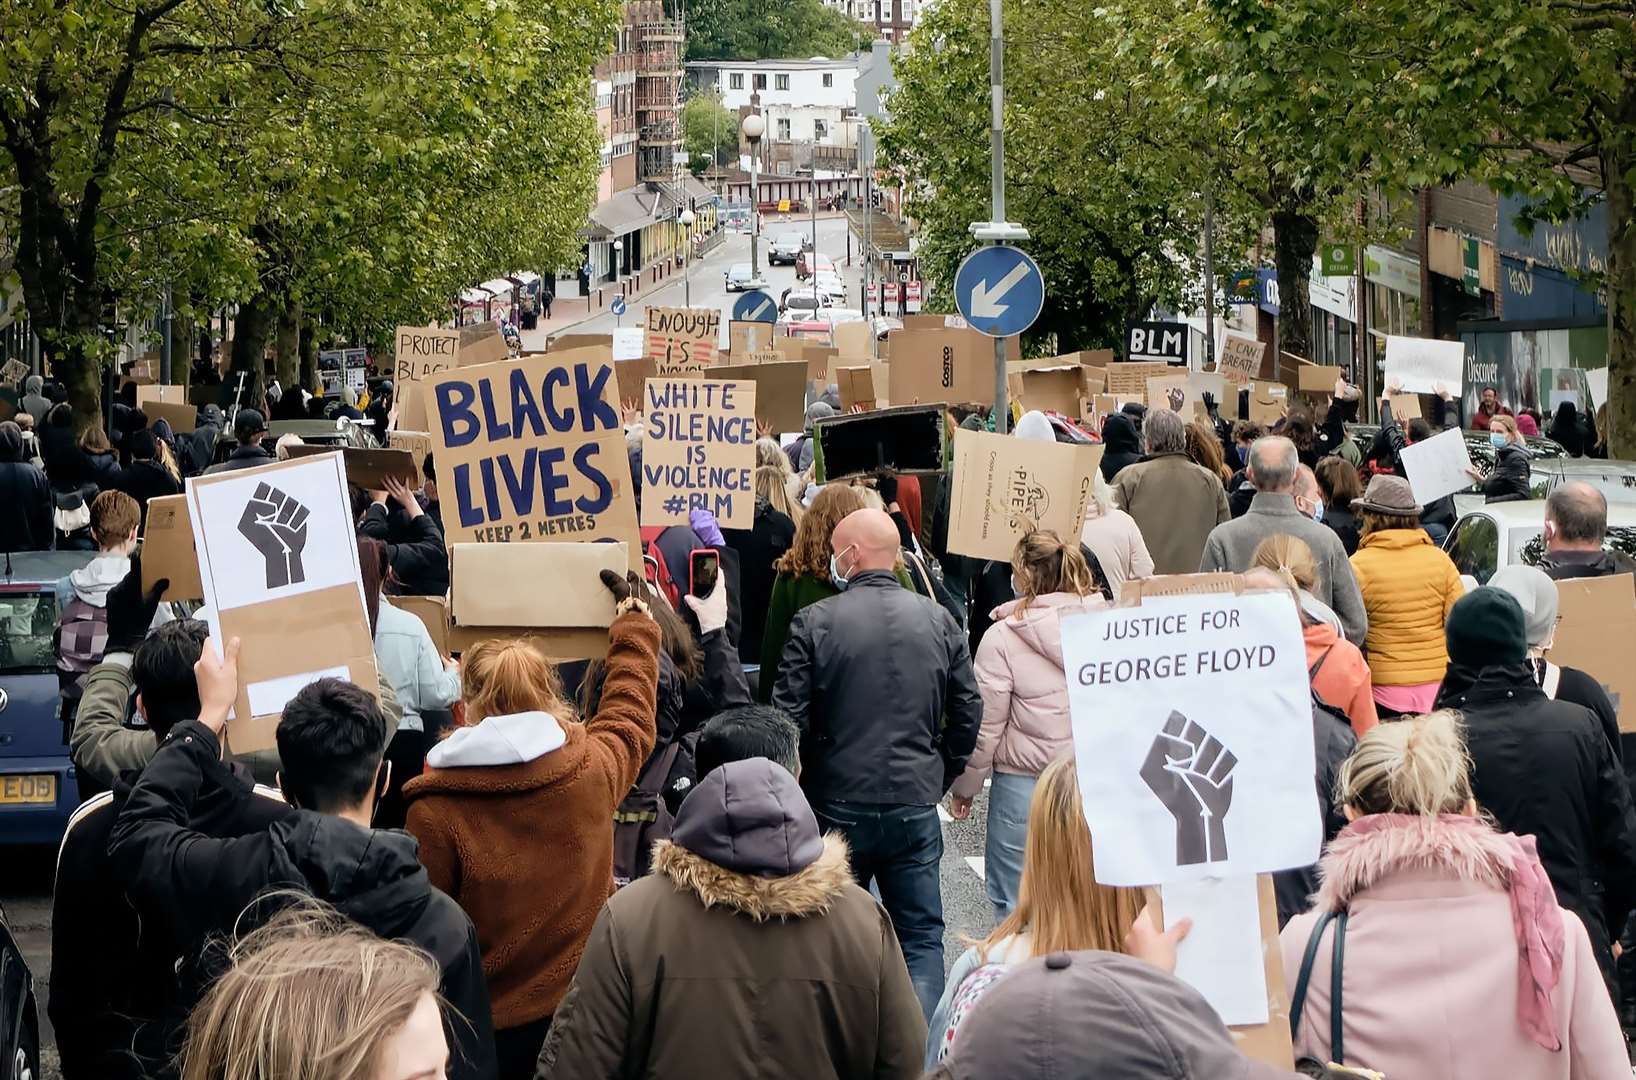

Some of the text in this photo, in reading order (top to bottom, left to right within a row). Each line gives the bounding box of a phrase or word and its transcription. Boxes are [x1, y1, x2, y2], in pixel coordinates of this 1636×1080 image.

[648, 308, 720, 338] ENOUGH
[400, 333, 458, 357] PROTECT
[1130, 328, 1182, 355] BLM
[398, 360, 449, 381] BLAC
[941, 345, 950, 388] COSTCO
[1467, 355, 1498, 383] Discover
[435, 363, 619, 449] BLACK
[649, 383, 737, 410] WHITE
[649, 411, 755, 444] SILENCE
[686, 445, 706, 465] IS
[453, 442, 614, 528] LIVES
[644, 463, 752, 491] VIOLENCE
[663, 493, 733, 518] #BLM
[1009, 470, 1027, 529] PIPES
[474, 515, 596, 543] KEEP 2 METRES
[1102, 608, 1240, 641] JUSTICE FOR
[1078, 644, 1276, 687] GEORGE FLOYD
